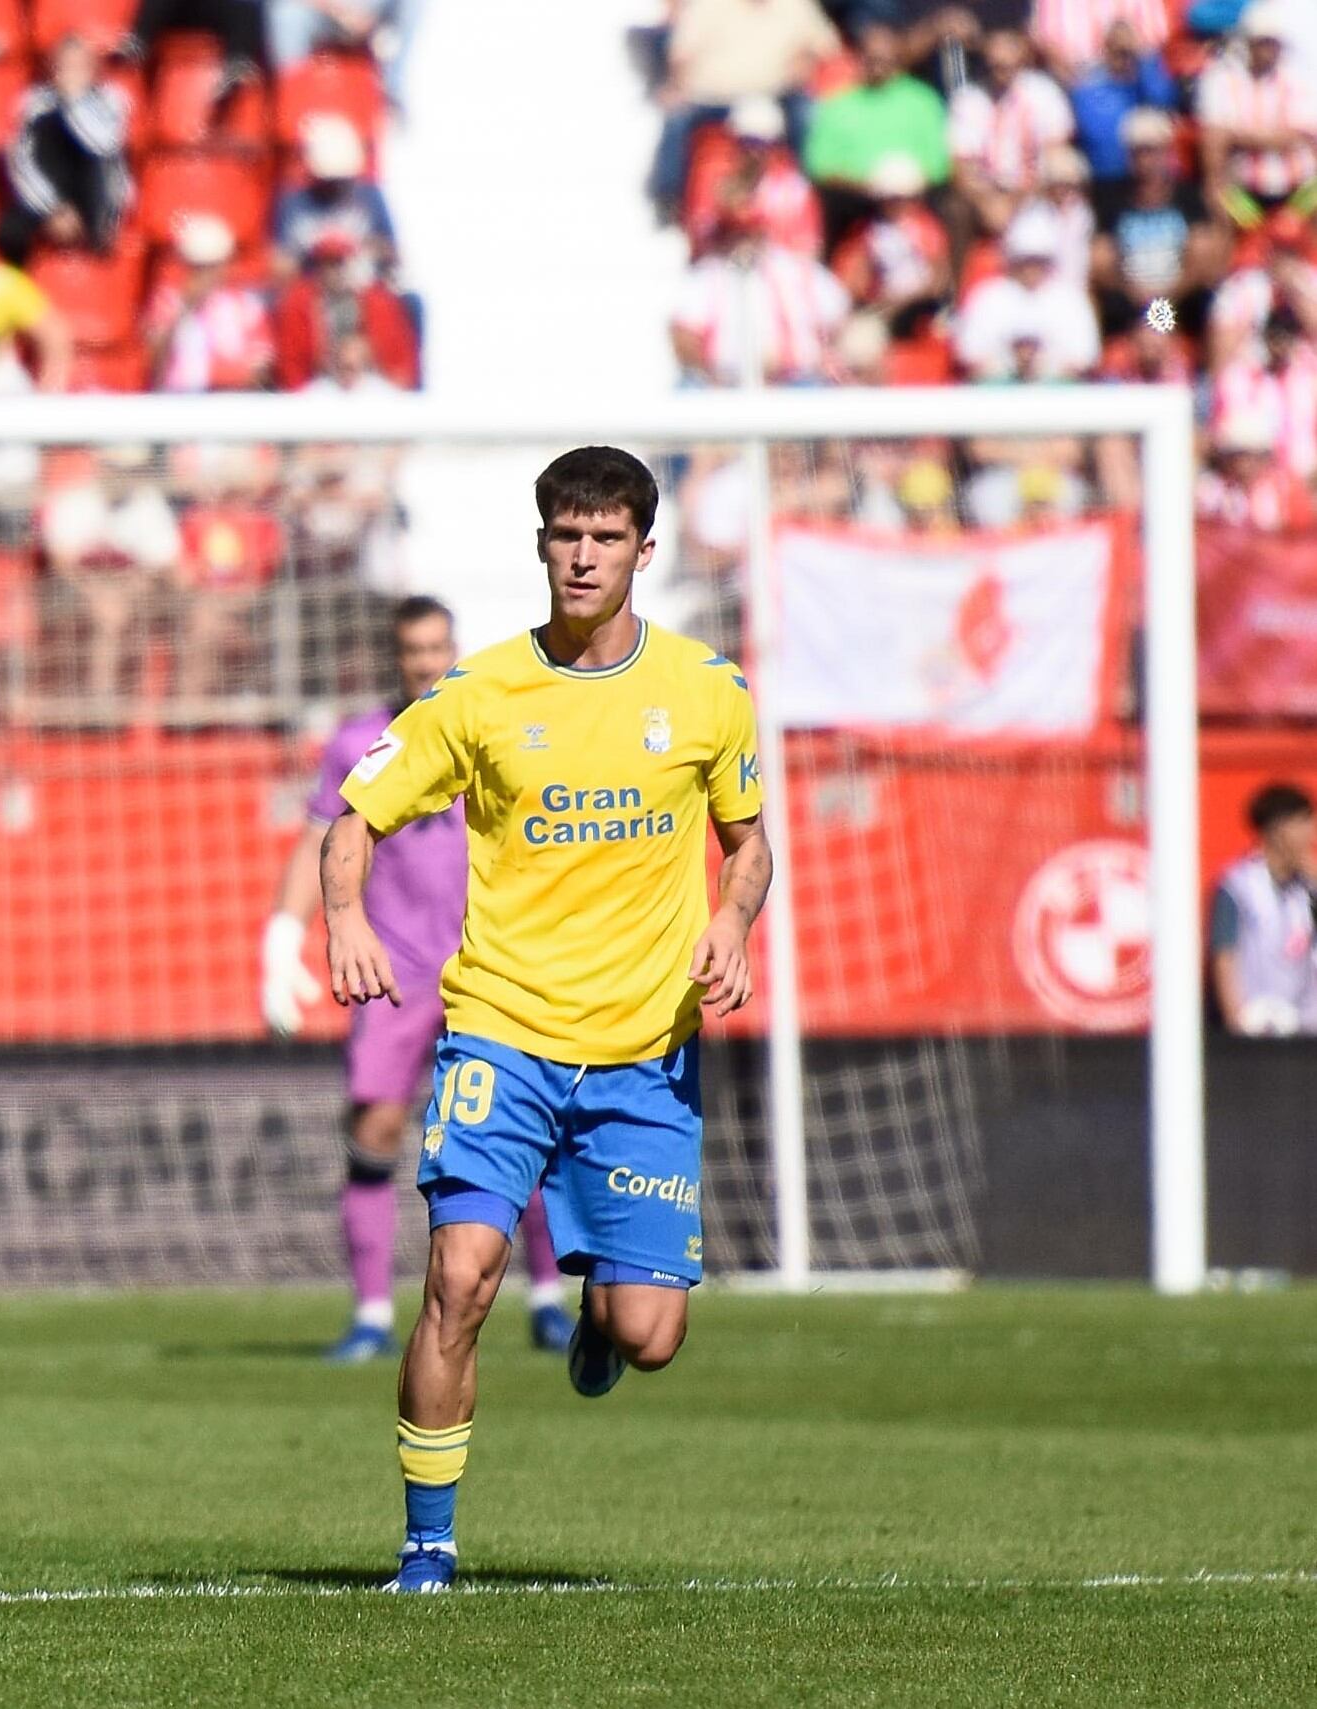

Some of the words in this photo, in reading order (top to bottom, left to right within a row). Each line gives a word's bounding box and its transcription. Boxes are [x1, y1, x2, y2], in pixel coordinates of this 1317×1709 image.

[541, 782, 642, 813] Gran
[523, 809, 675, 845] Canaria
[439, 1059, 495, 1125] 19
